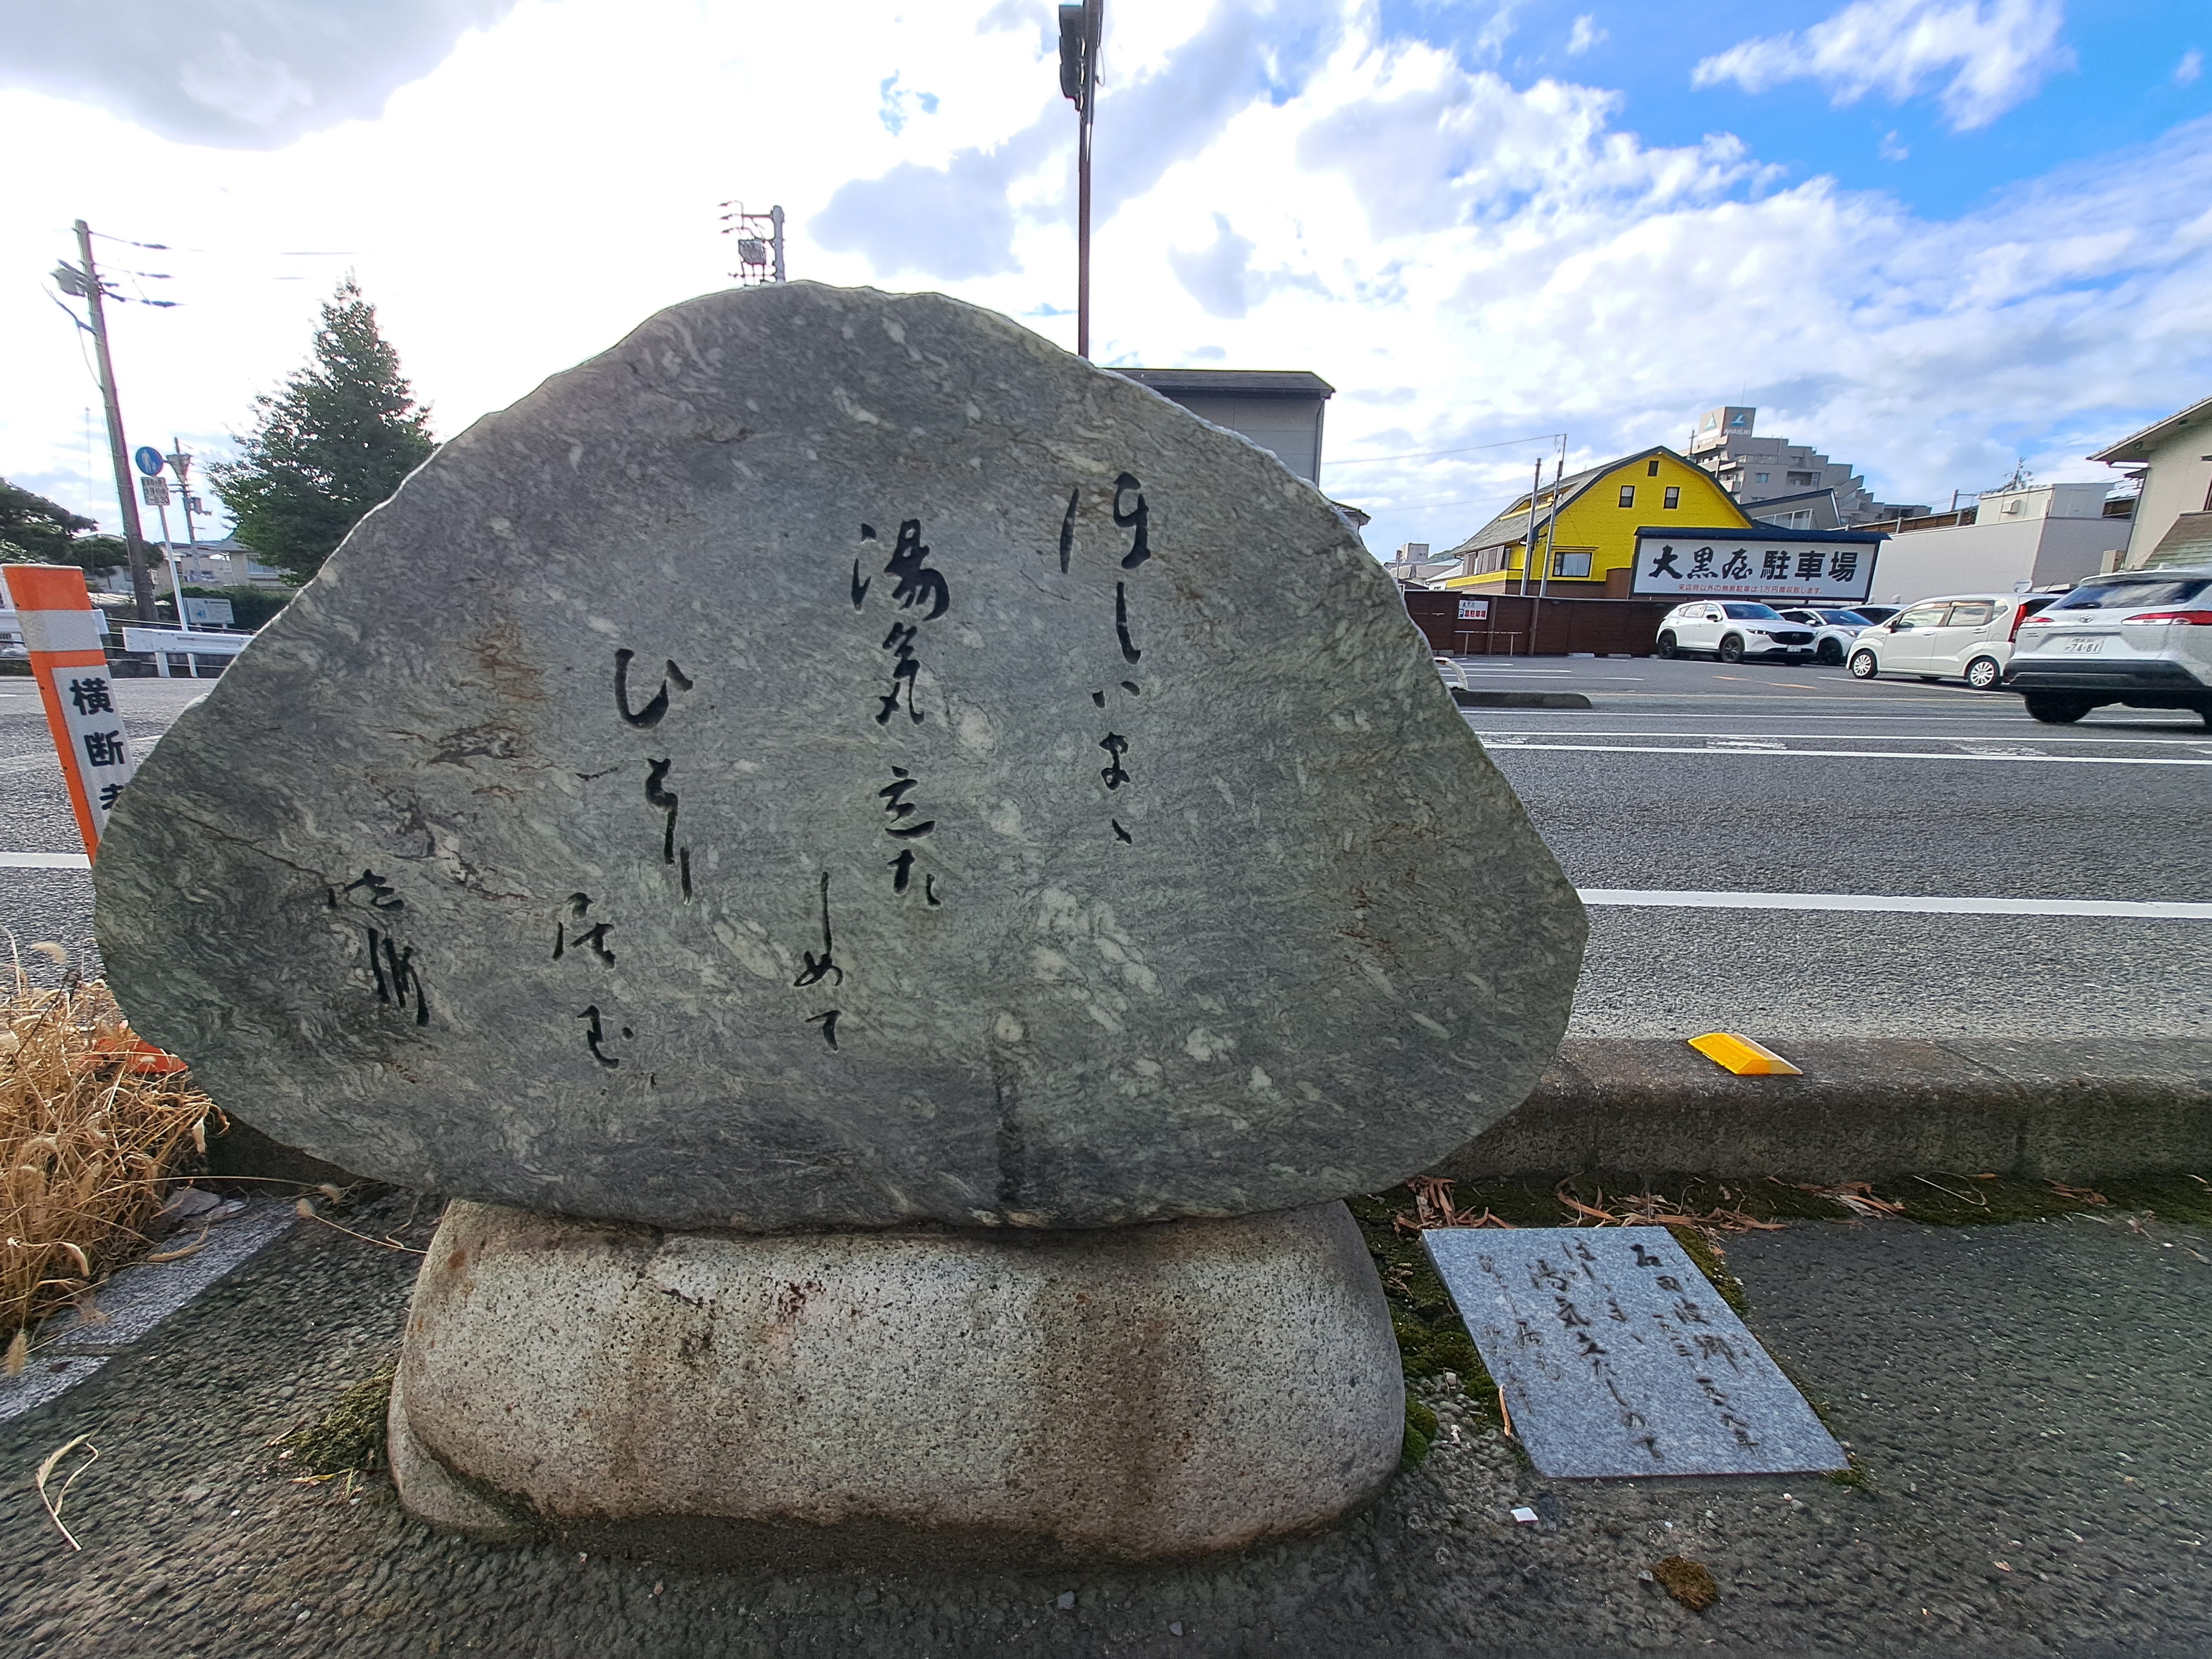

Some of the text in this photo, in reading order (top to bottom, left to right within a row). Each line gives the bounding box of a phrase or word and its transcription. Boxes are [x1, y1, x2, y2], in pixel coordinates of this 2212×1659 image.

[1648, 545, 1859, 582] 大黒屋駐車場
